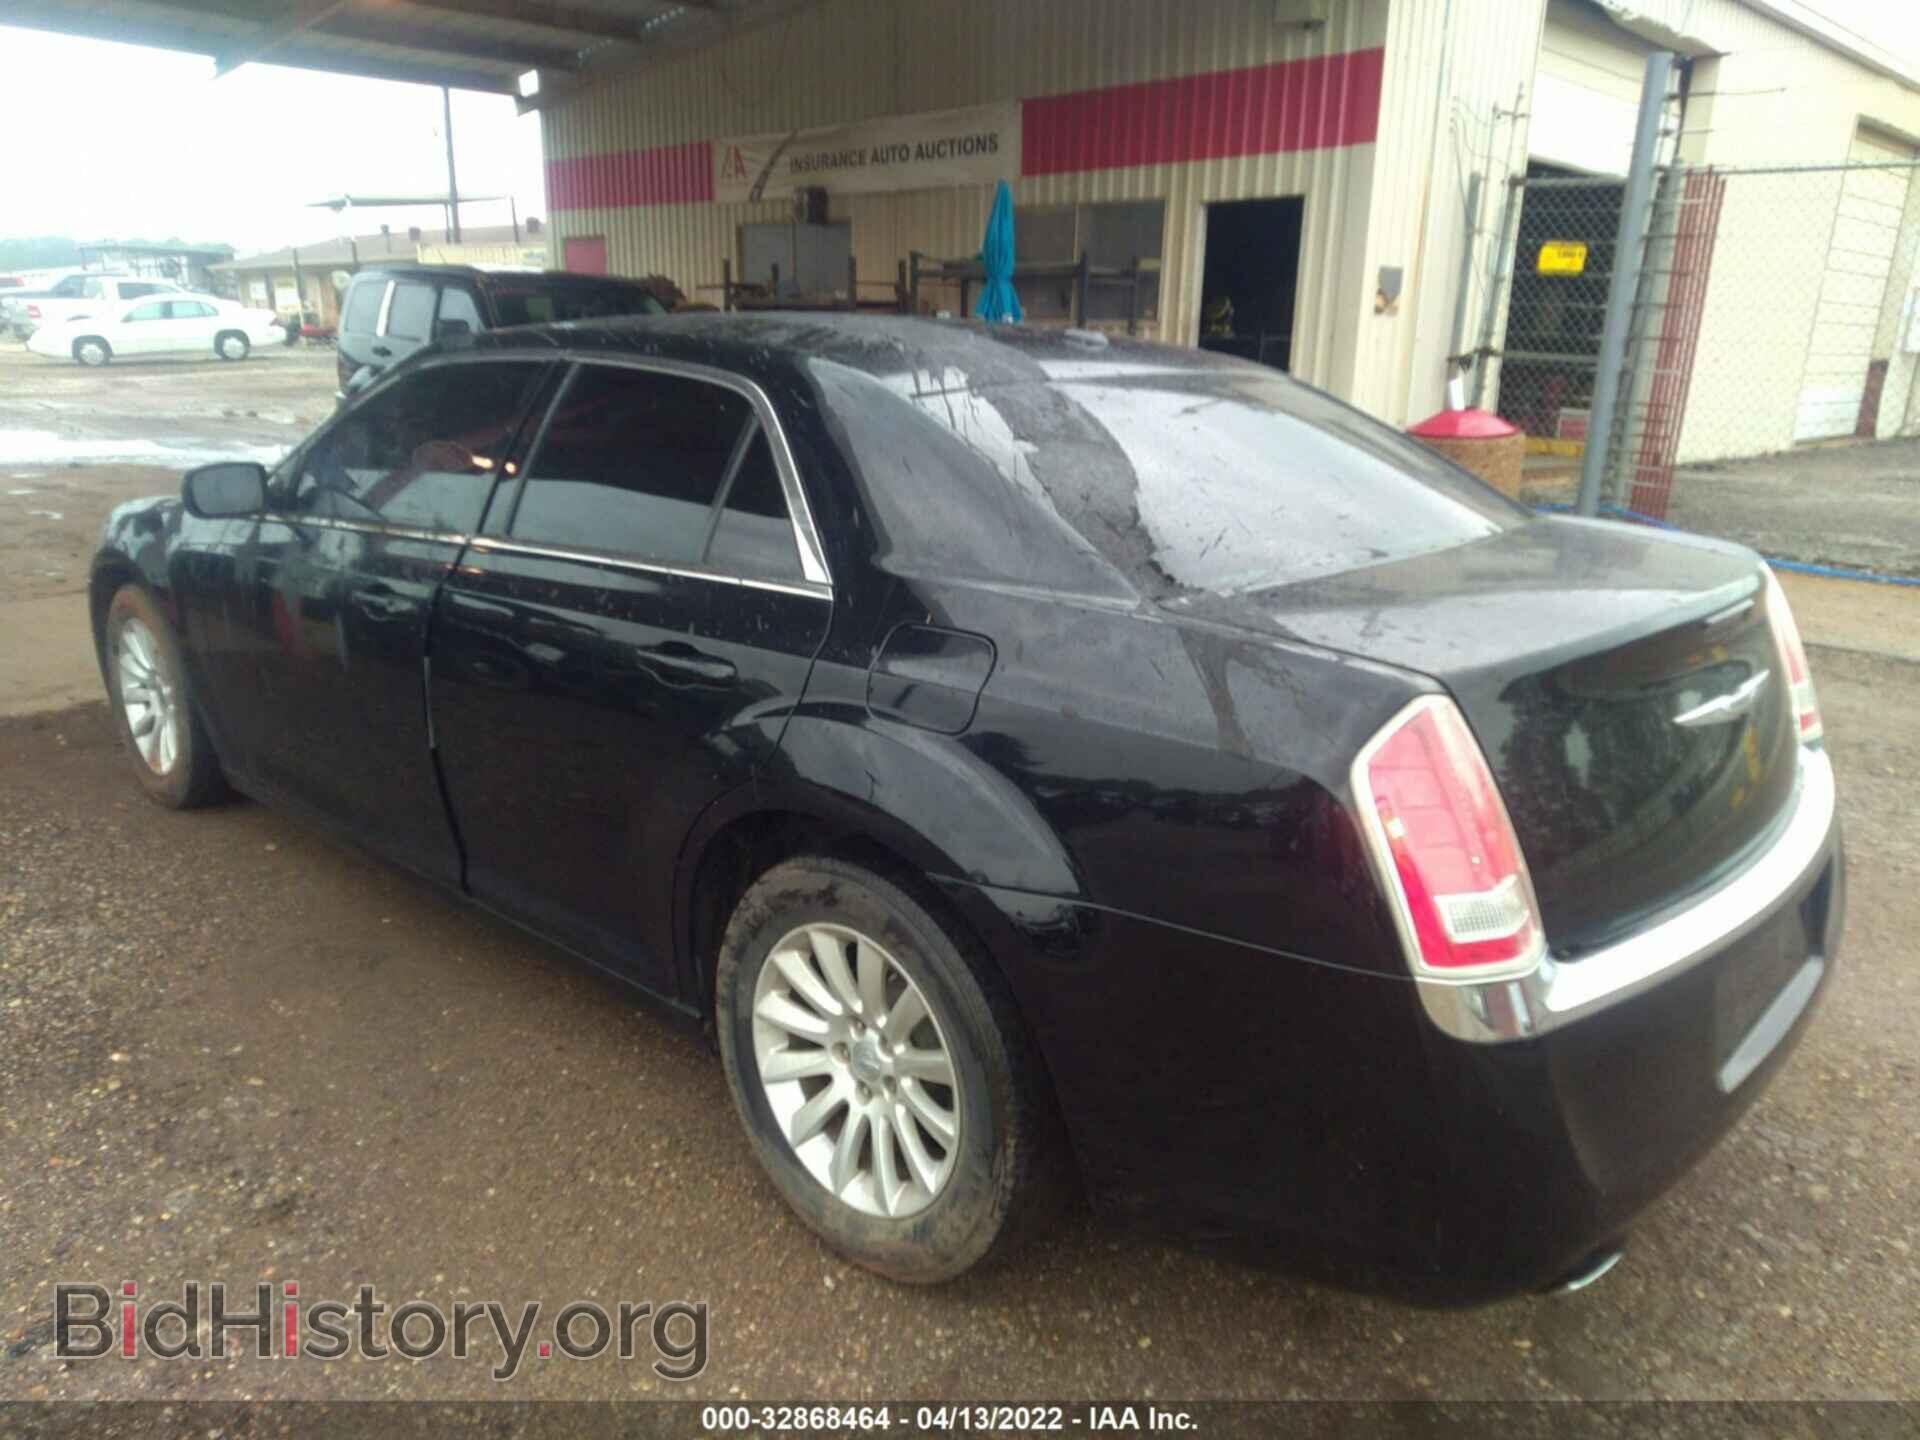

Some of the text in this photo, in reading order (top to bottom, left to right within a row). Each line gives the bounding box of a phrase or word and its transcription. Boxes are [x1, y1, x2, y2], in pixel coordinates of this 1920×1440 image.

[790, 131, 1000, 174] INSURANCE AUTO AUCTIONS
